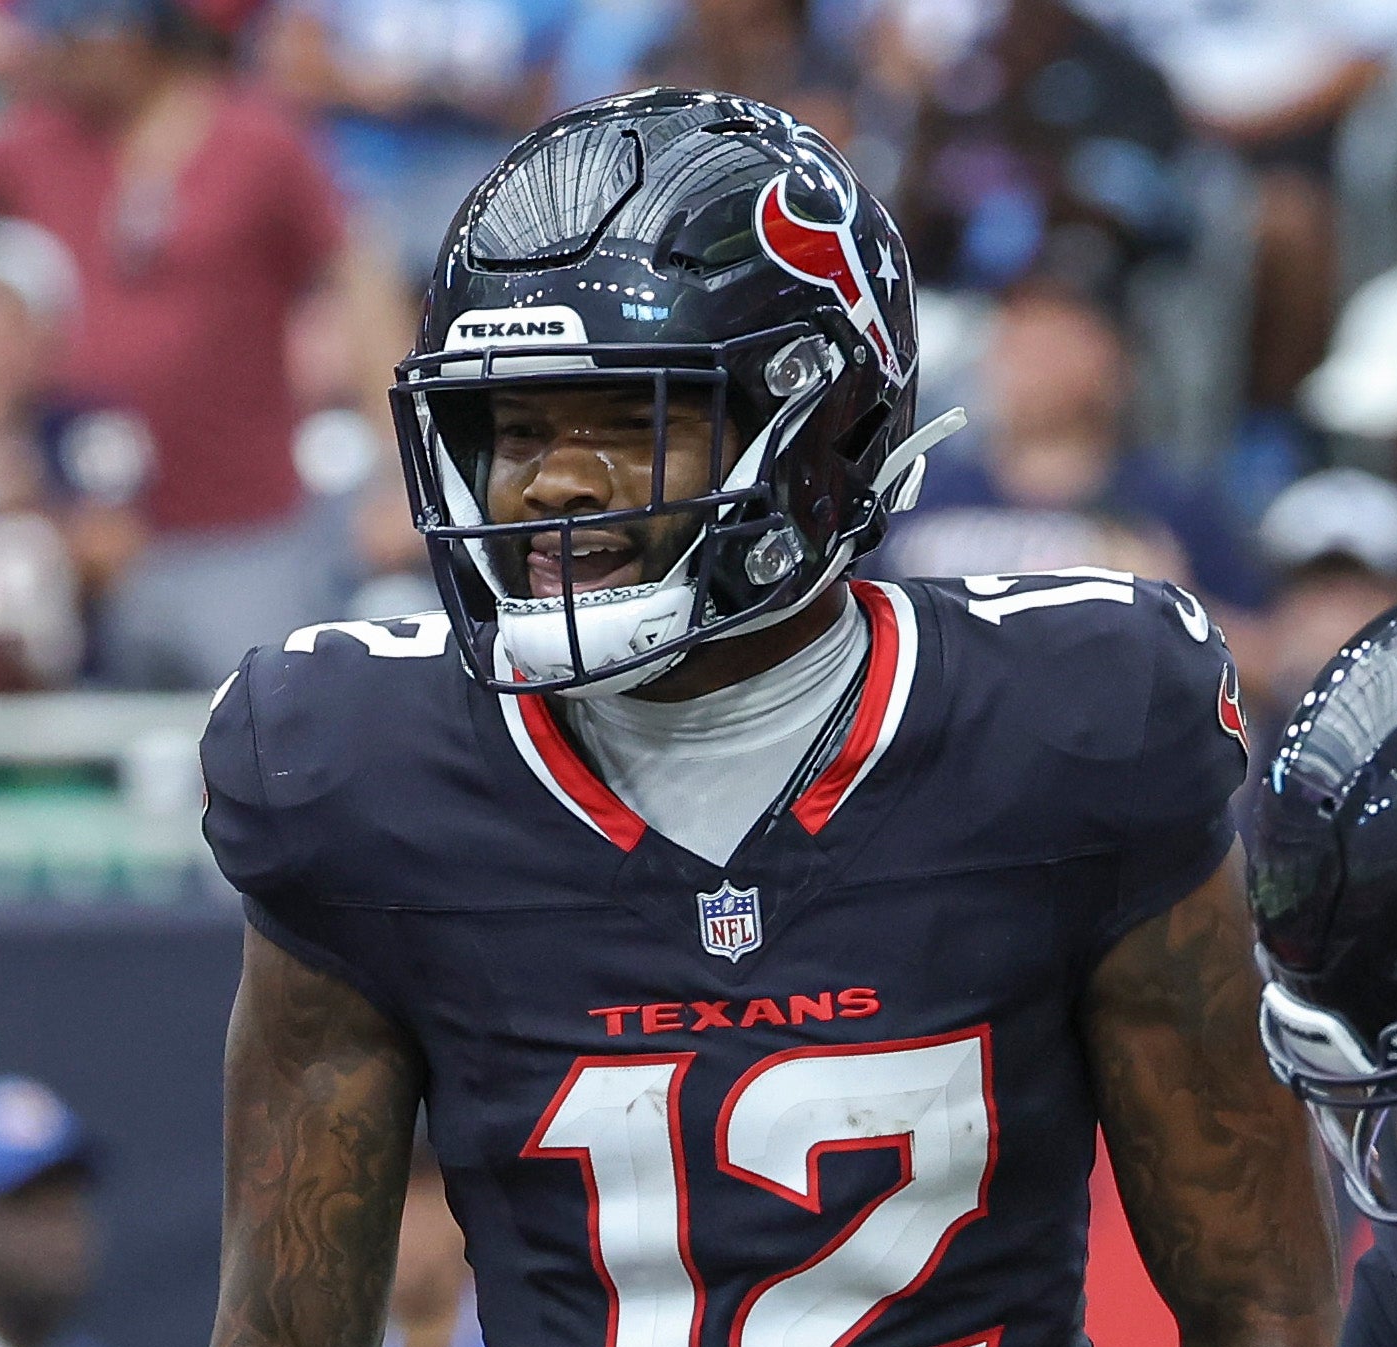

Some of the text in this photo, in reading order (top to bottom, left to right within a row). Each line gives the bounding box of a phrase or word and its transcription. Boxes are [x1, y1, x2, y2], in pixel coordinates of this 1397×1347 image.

[457, 321, 565, 338] TEXANS
[710, 918, 753, 947] NFL
[587, 987, 882, 1037] TEXANS
